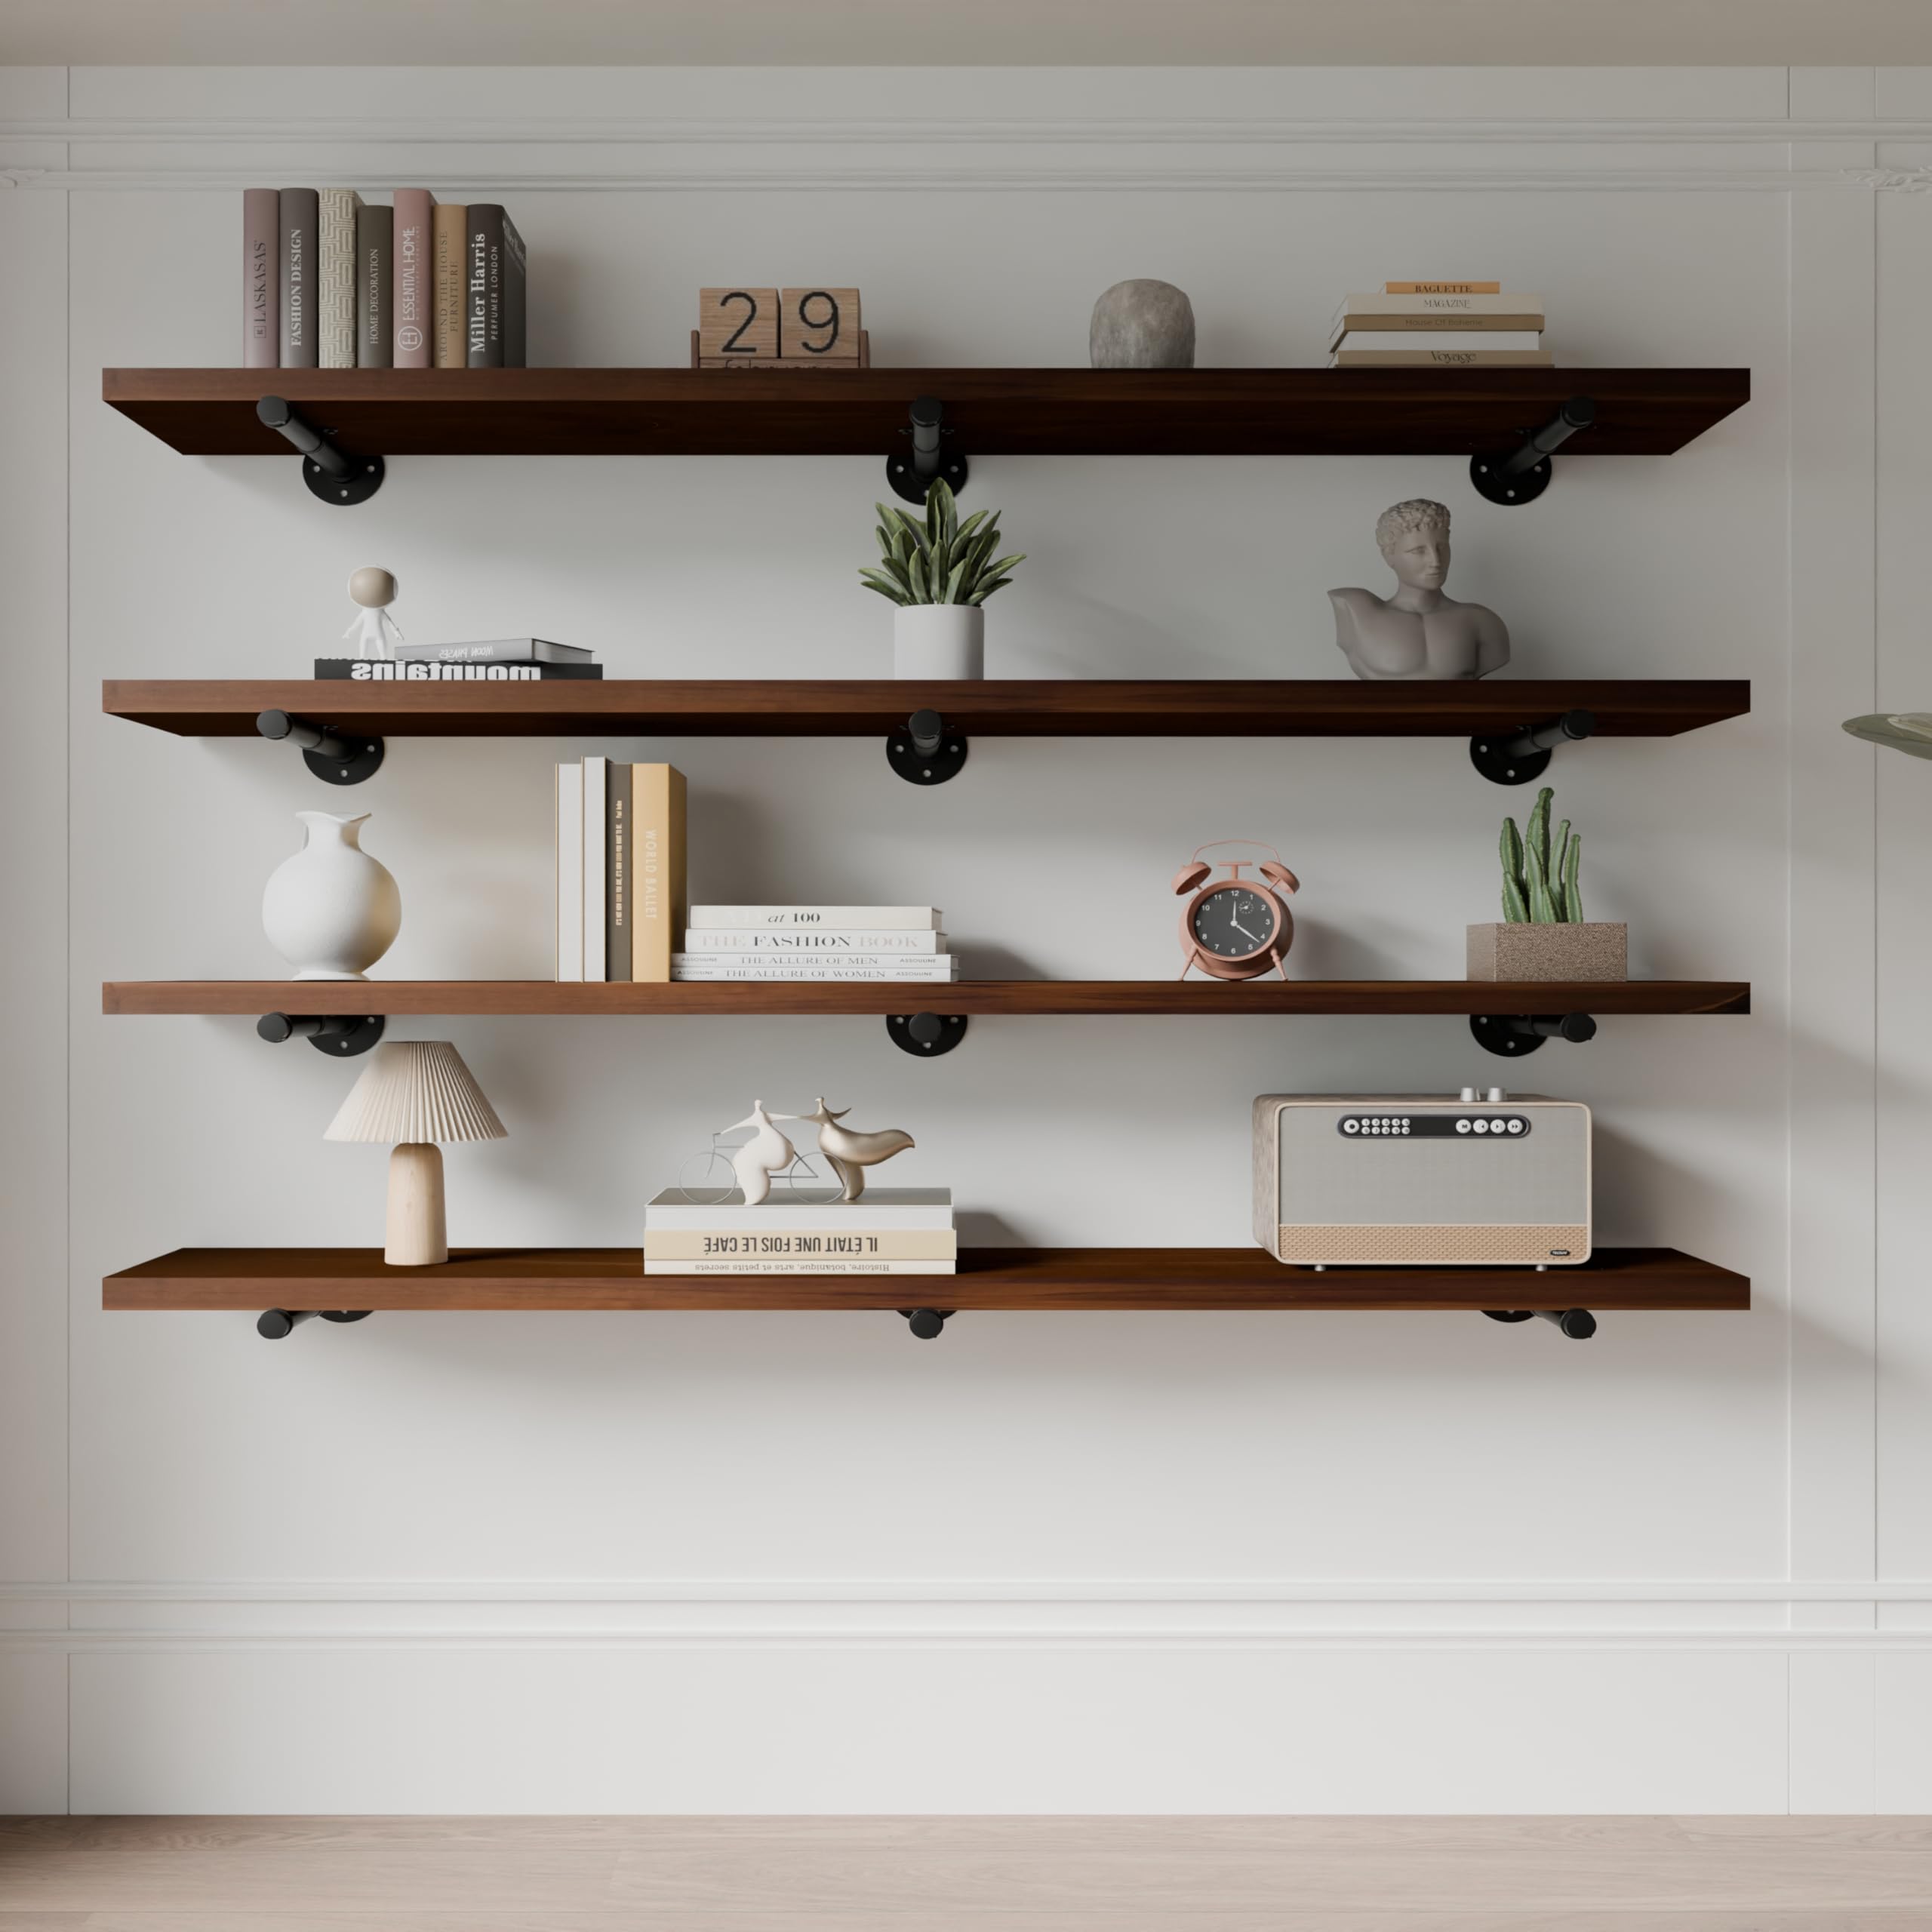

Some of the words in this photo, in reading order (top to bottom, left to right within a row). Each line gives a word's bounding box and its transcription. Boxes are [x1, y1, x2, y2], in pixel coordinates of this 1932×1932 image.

[402, 226, 415, 263] HOME
[439, 230, 448, 272] HOUSE
[291, 229, 303, 288] DESIGN
[470, 233, 486, 293] Harris
[490, 245, 499, 288] LONDON
[253, 242, 266, 324] LASKASAS
[369, 248, 380, 314] DECORATION
[439, 278, 448, 303] THE
[1414, 285, 1473, 294] BAGUETTE
[402, 264, 415, 321] ESSENTIAL
[449, 260, 459, 332] FURNITURE
[1423, 299, 1472, 309] MAGAZINE
[291, 289, 303, 347] FASHION
[470, 297, 486, 352] Miller
[490, 292, 499, 340] PERFUMER
[369, 315, 380, 344] HOME
[439, 308, 448, 361] AROUND
[1430, 350, 1477, 364] Voyage
[645, 829, 657, 874] WORLD
[645, 878, 657, 920] BALLET
[768, 912, 786, 923] at
[792, 912, 821, 923] 100
[700, 936, 745, 947] THE
[754, 936, 852, 947] FASHION
[859, 936, 919, 947] BOOK
[741, 956, 765, 964] THE
[768, 956, 823, 964] ALLURE
[826, 956, 844, 964] OF
[848, 956, 878, 964] MEN
[724, 969, 751, 978] THE
[754, 969, 808, 978] ALLURE
[811, 969, 828, 978] OF
[832, 969, 886, 978] WOMEN
[703, 1237, 738, 1256] CAFÉ
[741, 1237, 758, 1252] LE
[761, 1237, 791, 1252] FOIS
[795, 1237, 821, 1252] UNE
[825, 1237, 863, 1256] ÉTAIT
[866, 1237, 878, 1252] IL
[694, 1263, 730, 1272] secrets
[732, 1263, 759, 1272] petits
[761, 1263, 772, 1272] et
[775, 1263, 795, 1272] arts
[797, 1263, 846, 1272] botanique,
[848, 1263, 890, 1272] Histoire,
